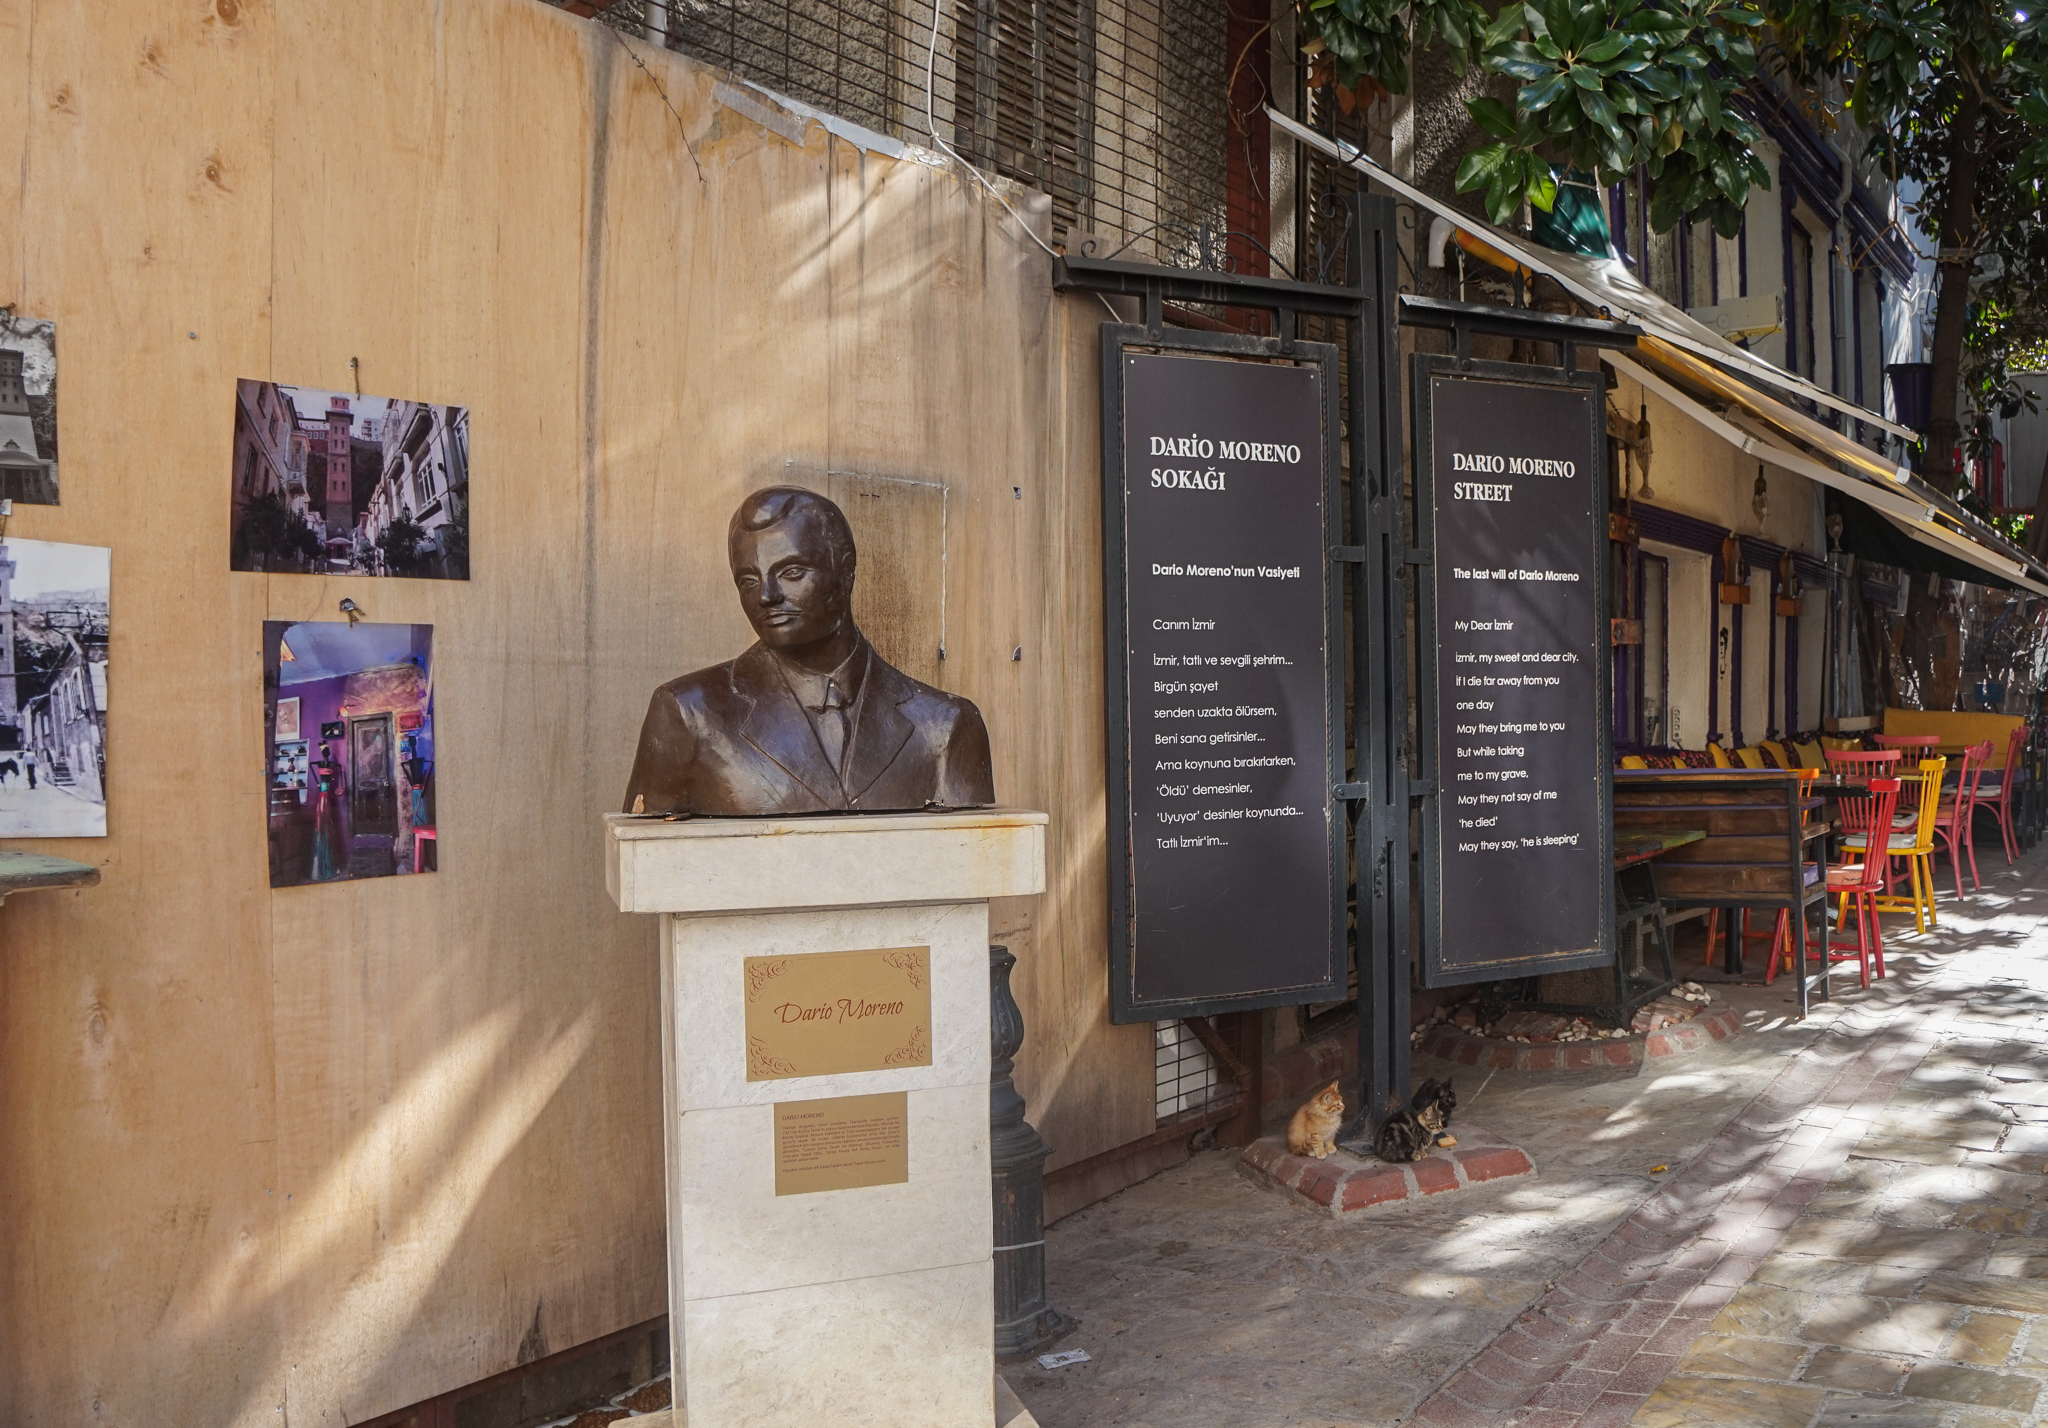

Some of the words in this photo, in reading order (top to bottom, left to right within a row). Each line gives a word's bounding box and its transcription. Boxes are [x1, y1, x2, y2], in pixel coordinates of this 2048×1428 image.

[1150, 433, 1213, 458] DARİO
[1219, 441, 1301, 463] MORENO
[1453, 453, 1505, 473] DARIO
[1509, 457, 1575, 478] MORENO
[1151, 466, 1225, 490] SOKAĞI
[1454, 482, 1512, 502] STREET
[1152, 564, 1183, 575] Dario
[1257, 566, 1300, 580] Vasiyeti
[1453, 568, 1471, 579] The
[1473, 568, 1490, 579] last
[1491, 569, 1506, 579] will
[1508, 569, 1517, 580] of
[1519, 570, 1543, 580] Dario
[1545, 571, 1579, 581] Moreno
[1153, 619, 1189, 630] Canım
[1192, 618, 1215, 630] İzmir
[1455, 621, 1469, 632] My
[1471, 620, 1493, 630] Dear
[1154, 653, 1179, 666] İzmir,
[1182, 655, 1201, 665] tatlı
[1204, 657, 1217, 665] ve
[1220, 655, 1251, 667] sevgili
[1479, 655, 1493, 664] my
[1495, 653, 1520, 662] sweet
[1522, 653, 1539, 662] and
[1541, 652, 1561, 662] dear
[1154, 681, 1187, 694] Birgün
[1190, 681, 1218, 693] şayet
[1463, 677, 1465, 686] I
[1467, 676, 1482, 686] die
[1483, 676, 1496, 685] far
[1497, 678, 1522, 687] away
[1523, 675, 1543, 685] from
[1544, 677, 1559, 686] you
[1154, 707, 1194, 718] senden
[1198, 706, 1232, 717] uzakta
[1235, 706, 1277, 716] ölürsem,
[1456, 702, 1474, 710] one
[1476, 700, 1494, 711] day
[1457, 724, 1477, 735] May
[1479, 723, 1498, 734] they
[1500, 722, 1522, 734] bring
[1539, 722, 1548, 731] to
[1549, 723, 1565, 732] you
[1155, 733, 1177, 744] Beni
[1180, 735, 1206, 743] sana
[1457, 747, 1471, 757] But
[1473, 747, 1496, 756] while
[1498, 745, 1524, 757] taking
[1155, 761, 1182, 770] Ama
[1185, 759, 1231, 771] koynuna
[1234, 756, 1295, 767] bırakırlarken,
[1458, 773, 1472, 781] me
[1474, 771, 1484, 780] to
[1486, 772, 1500, 781] my
[1501, 770, 1528, 781] grave,
[1193, 783, 1252, 795] demesinler,
[1458, 795, 1478, 805] May
[1480, 794, 1499, 804] they
[1501, 792, 1515, 802] not
[1517, 793, 1531, 802] say
[1533, 790, 1542, 800] of
[1203, 809, 1244, 820] desinler
[1157, 838, 1177, 848] Tatlı
[1459, 843, 1479, 853] May
[1481, 841, 1500, 851] they
[1501, 841, 1518, 850] say,
[1536, 836, 1541, 846] is
[773, 1002, 833, 1024] Dario
[837, 998, 904, 1025] Moreno
